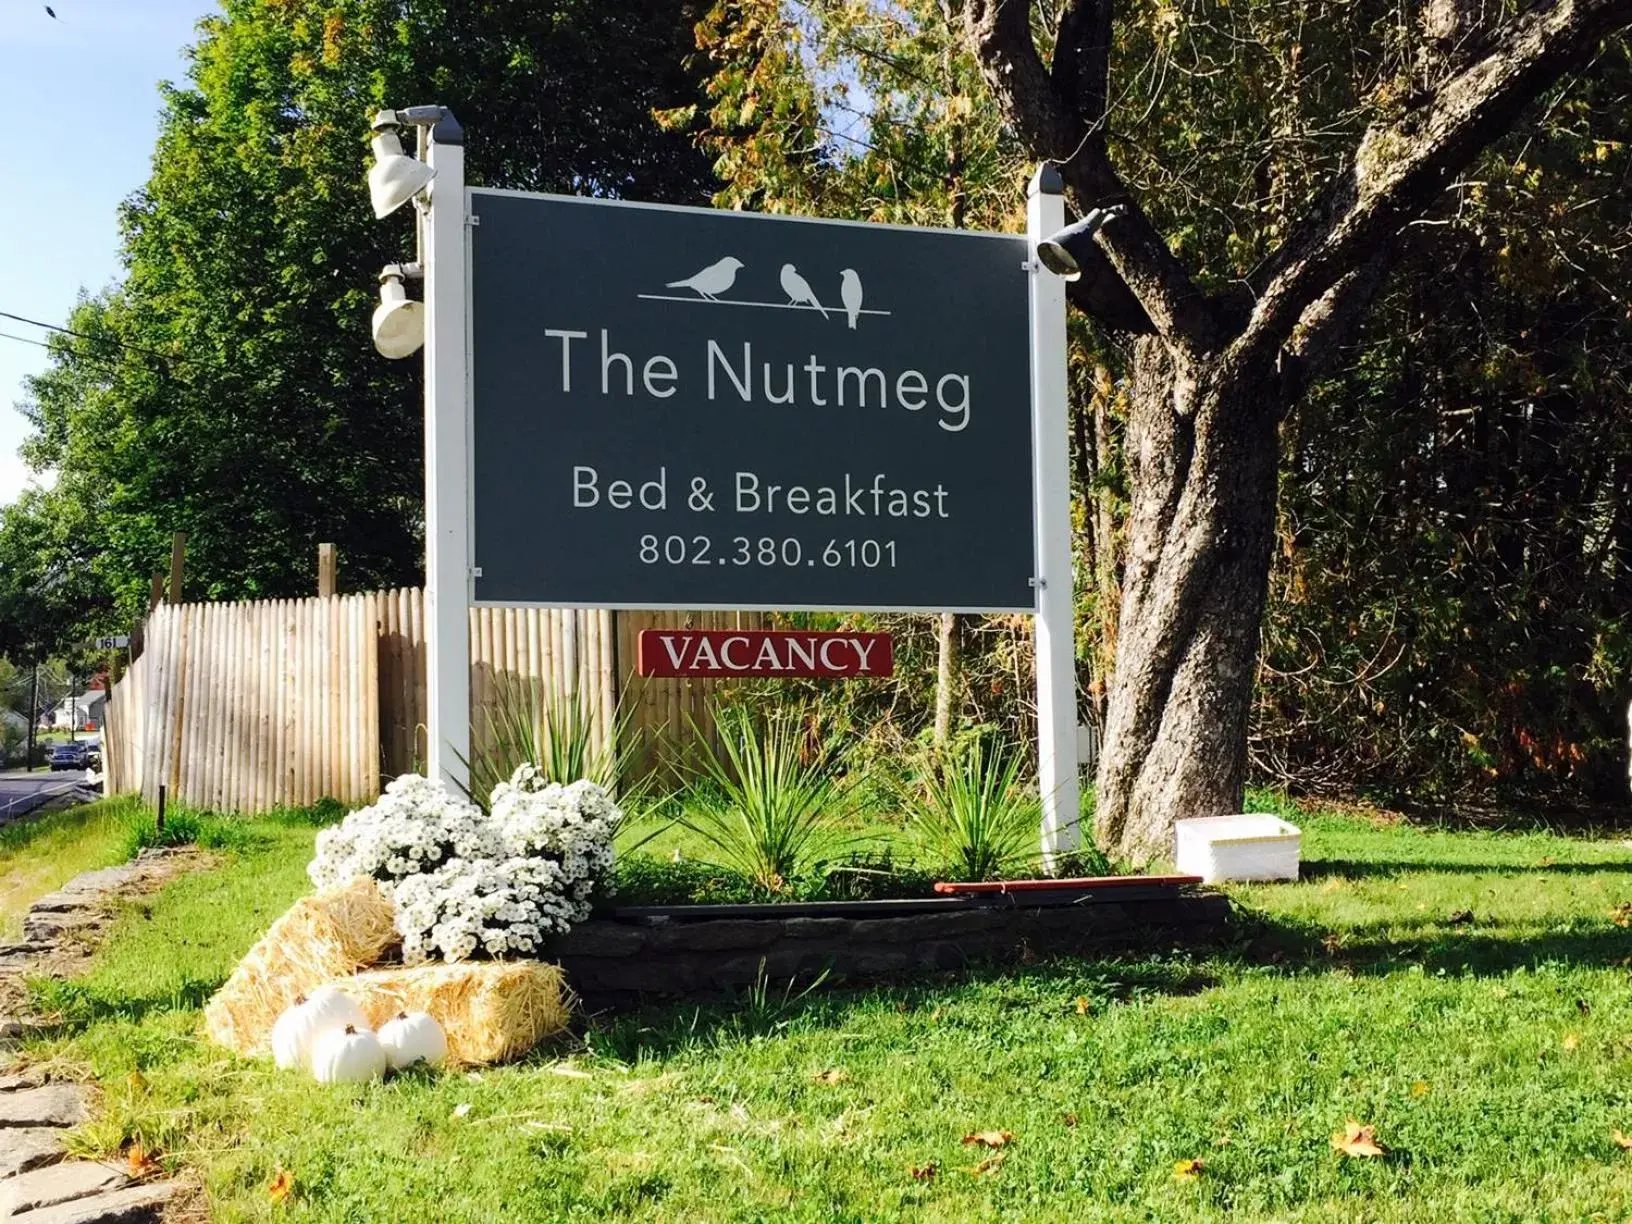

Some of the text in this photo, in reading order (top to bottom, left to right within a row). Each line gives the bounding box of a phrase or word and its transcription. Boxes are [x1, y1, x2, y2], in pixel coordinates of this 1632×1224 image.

[545, 329, 970, 432] The Nutmeg
[573, 466, 949, 518] Bed & Breakfast
[639, 534, 896, 568] 802.380.6101
[659, 636, 876, 671] VACANCY
